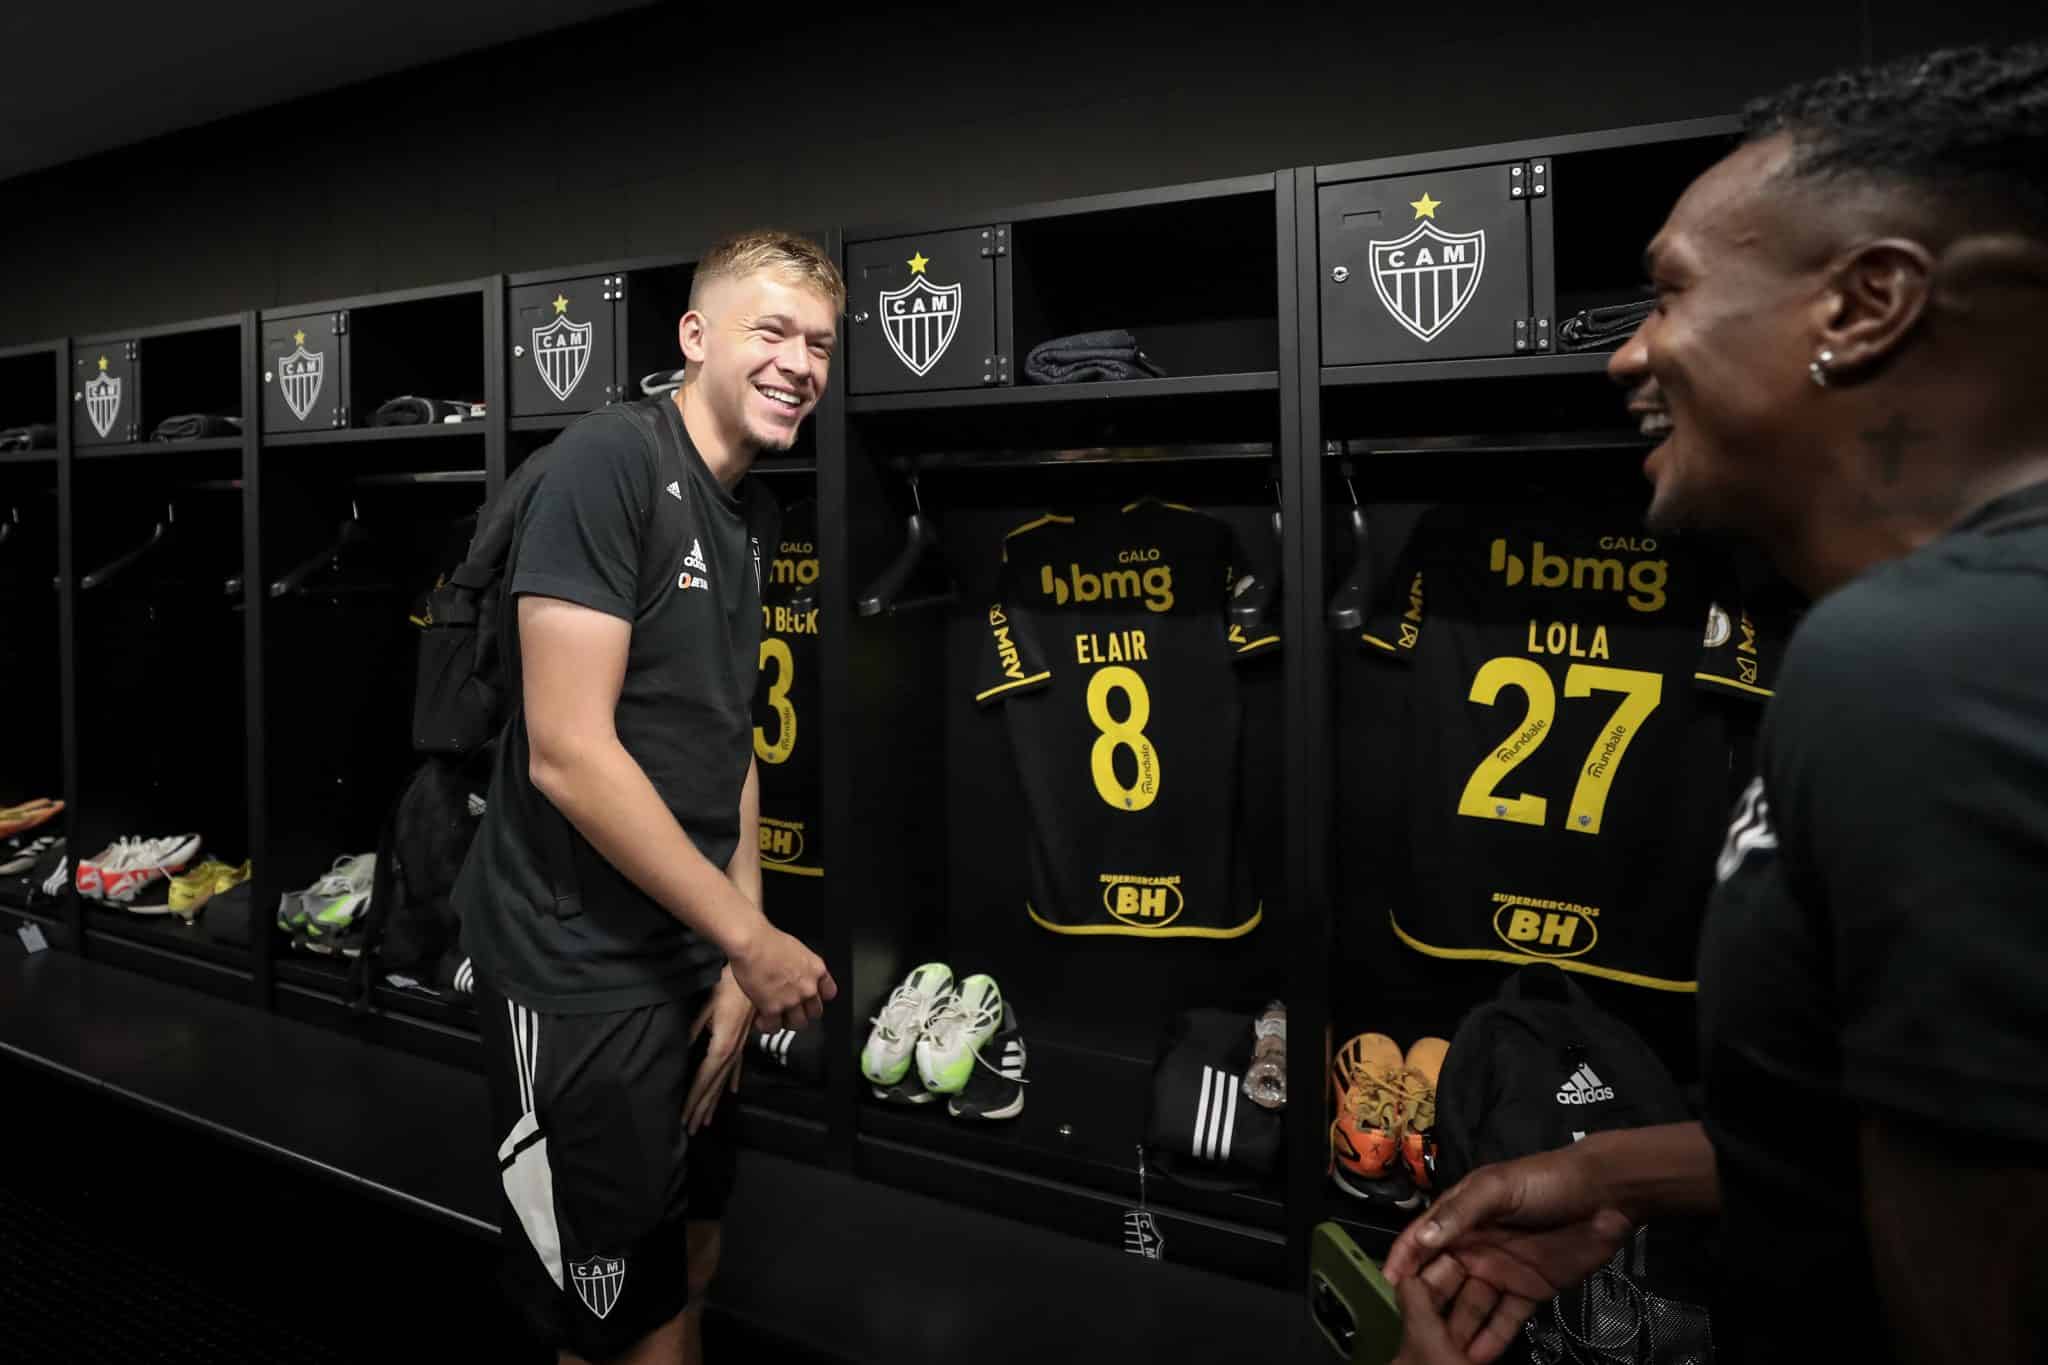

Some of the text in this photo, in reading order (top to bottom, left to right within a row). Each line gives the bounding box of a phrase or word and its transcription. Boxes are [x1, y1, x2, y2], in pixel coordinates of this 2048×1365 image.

[1388, 244, 1466, 268] CAM
[893, 295, 948, 315] CAM
[543, 332, 583, 348] CAM
[286, 361, 317, 374] CAM
[1118, 548, 1160, 564] GALO
[1600, 536, 1657, 553] GALO
[1071, 563, 1174, 612] bmg
[1531, 541, 1668, 612] bmg
[993, 626, 1025, 679] MRV
[1075, 629, 1149, 664] ELAIR
[1527, 619, 1610, 661] LOLA
[1086, 665, 1161, 812] 8
[1457, 656, 1664, 835] 27
[1499, 719, 1546, 763] mundiale
[1590, 725, 1627, 779] mundiale
[758, 826, 793, 855] BH
[1116, 885, 1167, 917] BH
[1507, 907, 1580, 948] BH
[1556, 1086, 1615, 1105] adidas
[577, 1261, 619, 1276] CAM
